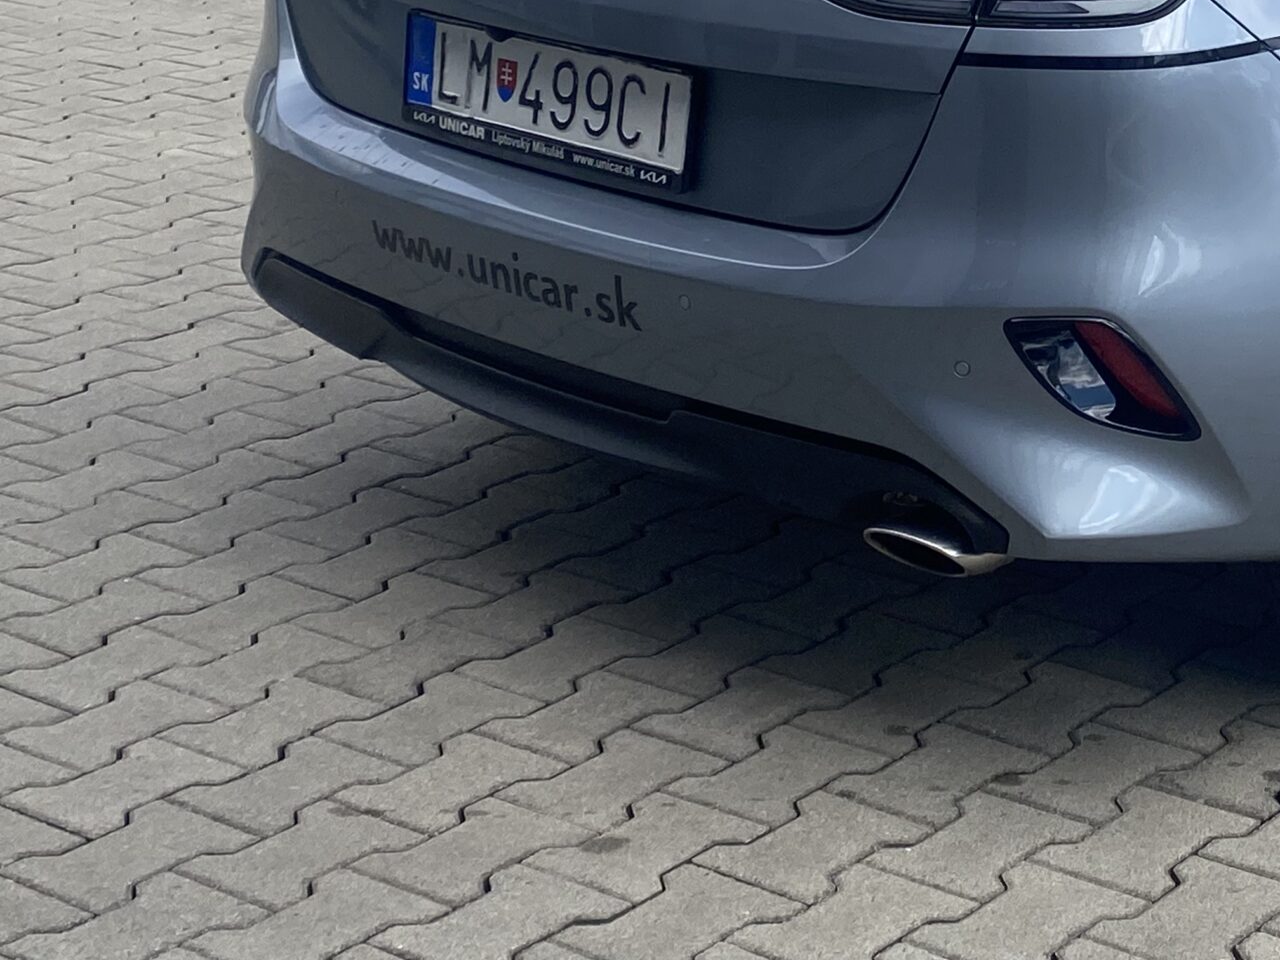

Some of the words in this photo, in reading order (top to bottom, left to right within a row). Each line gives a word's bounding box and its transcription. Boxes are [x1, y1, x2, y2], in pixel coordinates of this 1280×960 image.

[412, 71, 430, 93] SK
[438, 31, 493, 114] LM
[518, 51, 672, 155] 499CI
[438, 116, 485, 140] UNICAR
[491, 130, 531, 154] Liptovský
[572, 153, 636, 179] www.unicar.sk
[372, 219, 643, 333] www.unicar.sk
